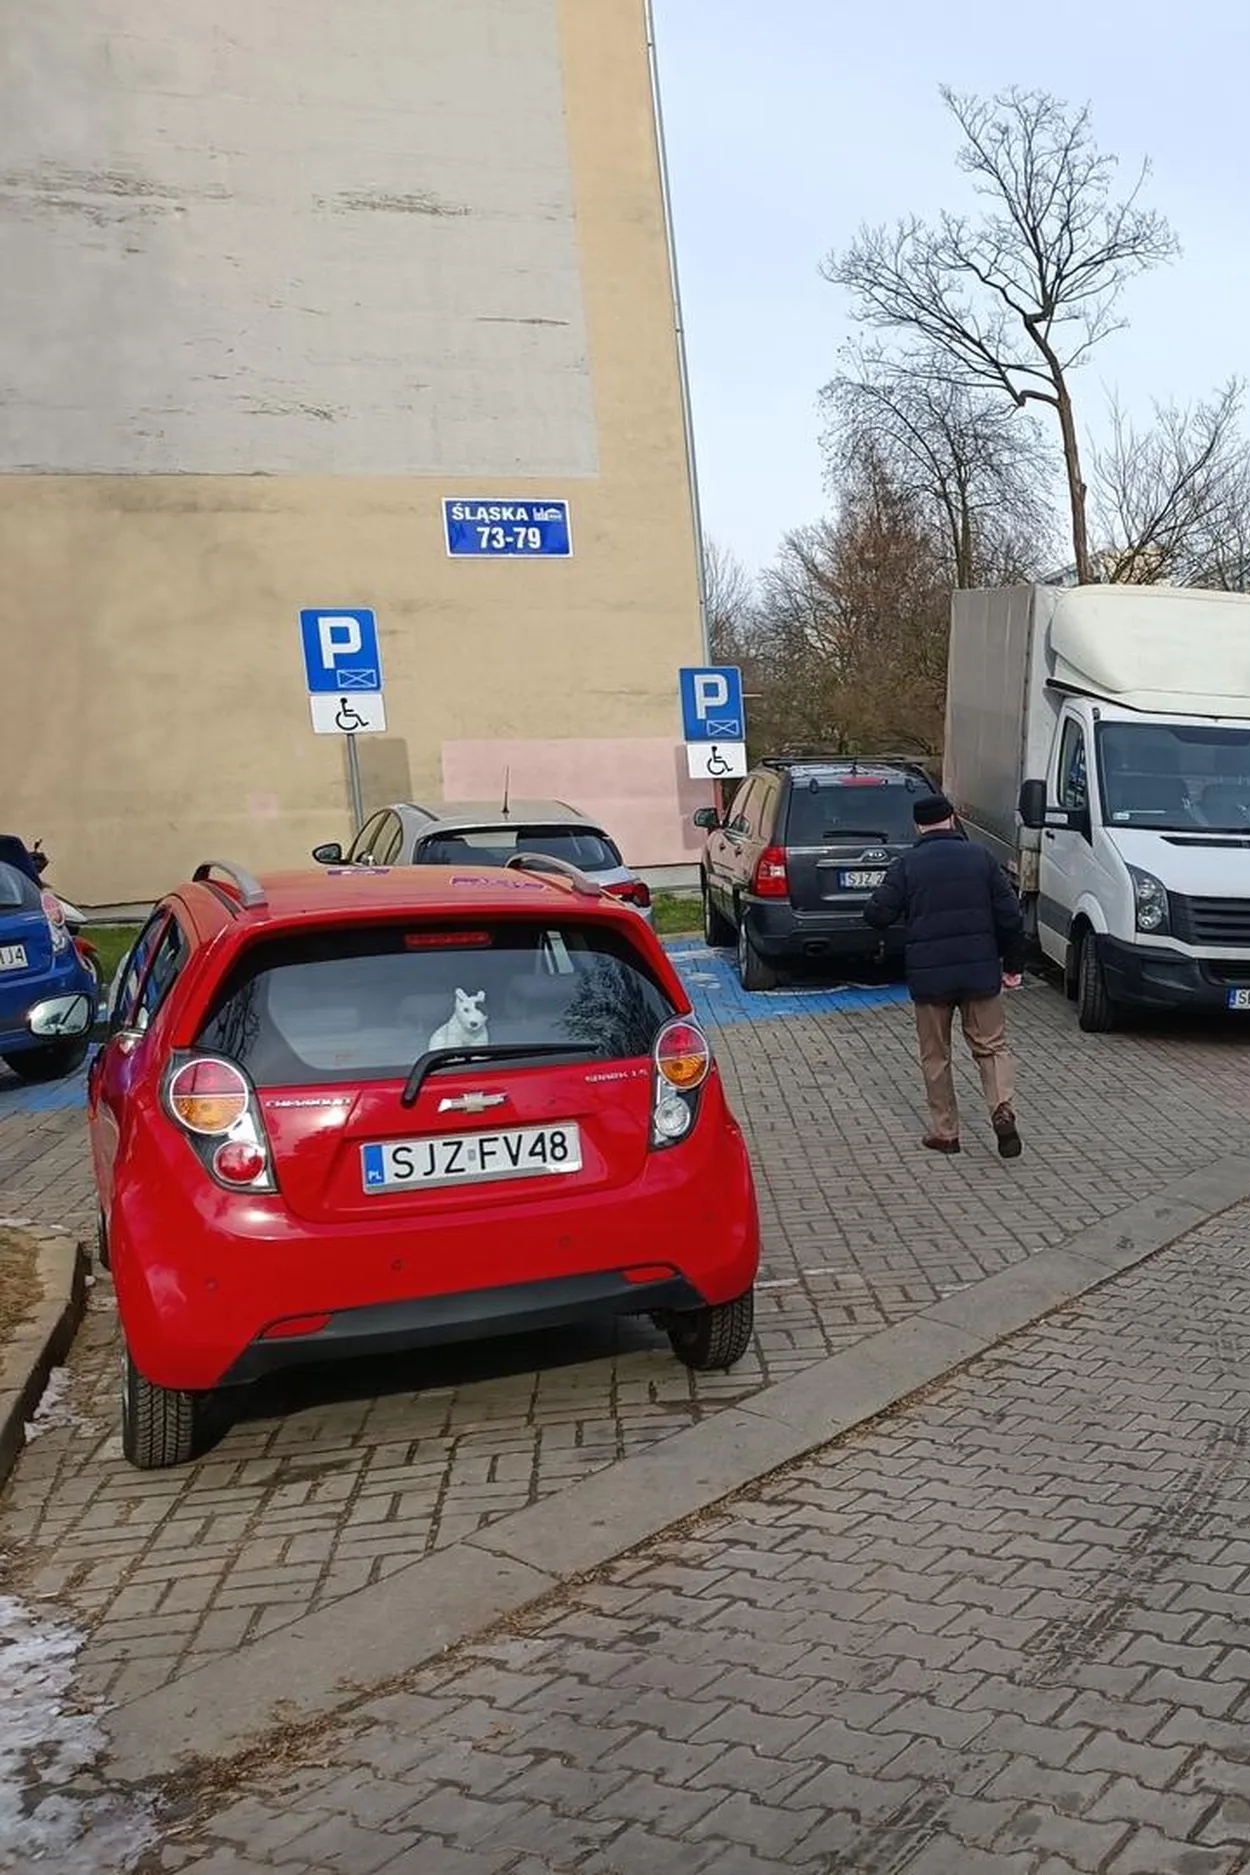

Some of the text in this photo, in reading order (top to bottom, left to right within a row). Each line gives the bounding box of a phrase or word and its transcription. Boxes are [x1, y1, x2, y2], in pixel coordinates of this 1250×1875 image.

[451, 503, 529, 524] ŚLĄSKA
[476, 527, 541, 549] 73-79
[317, 616, 362, 669] P
[694, 674, 728, 719] P
[391, 1131, 568, 1179] SJZ FV48
